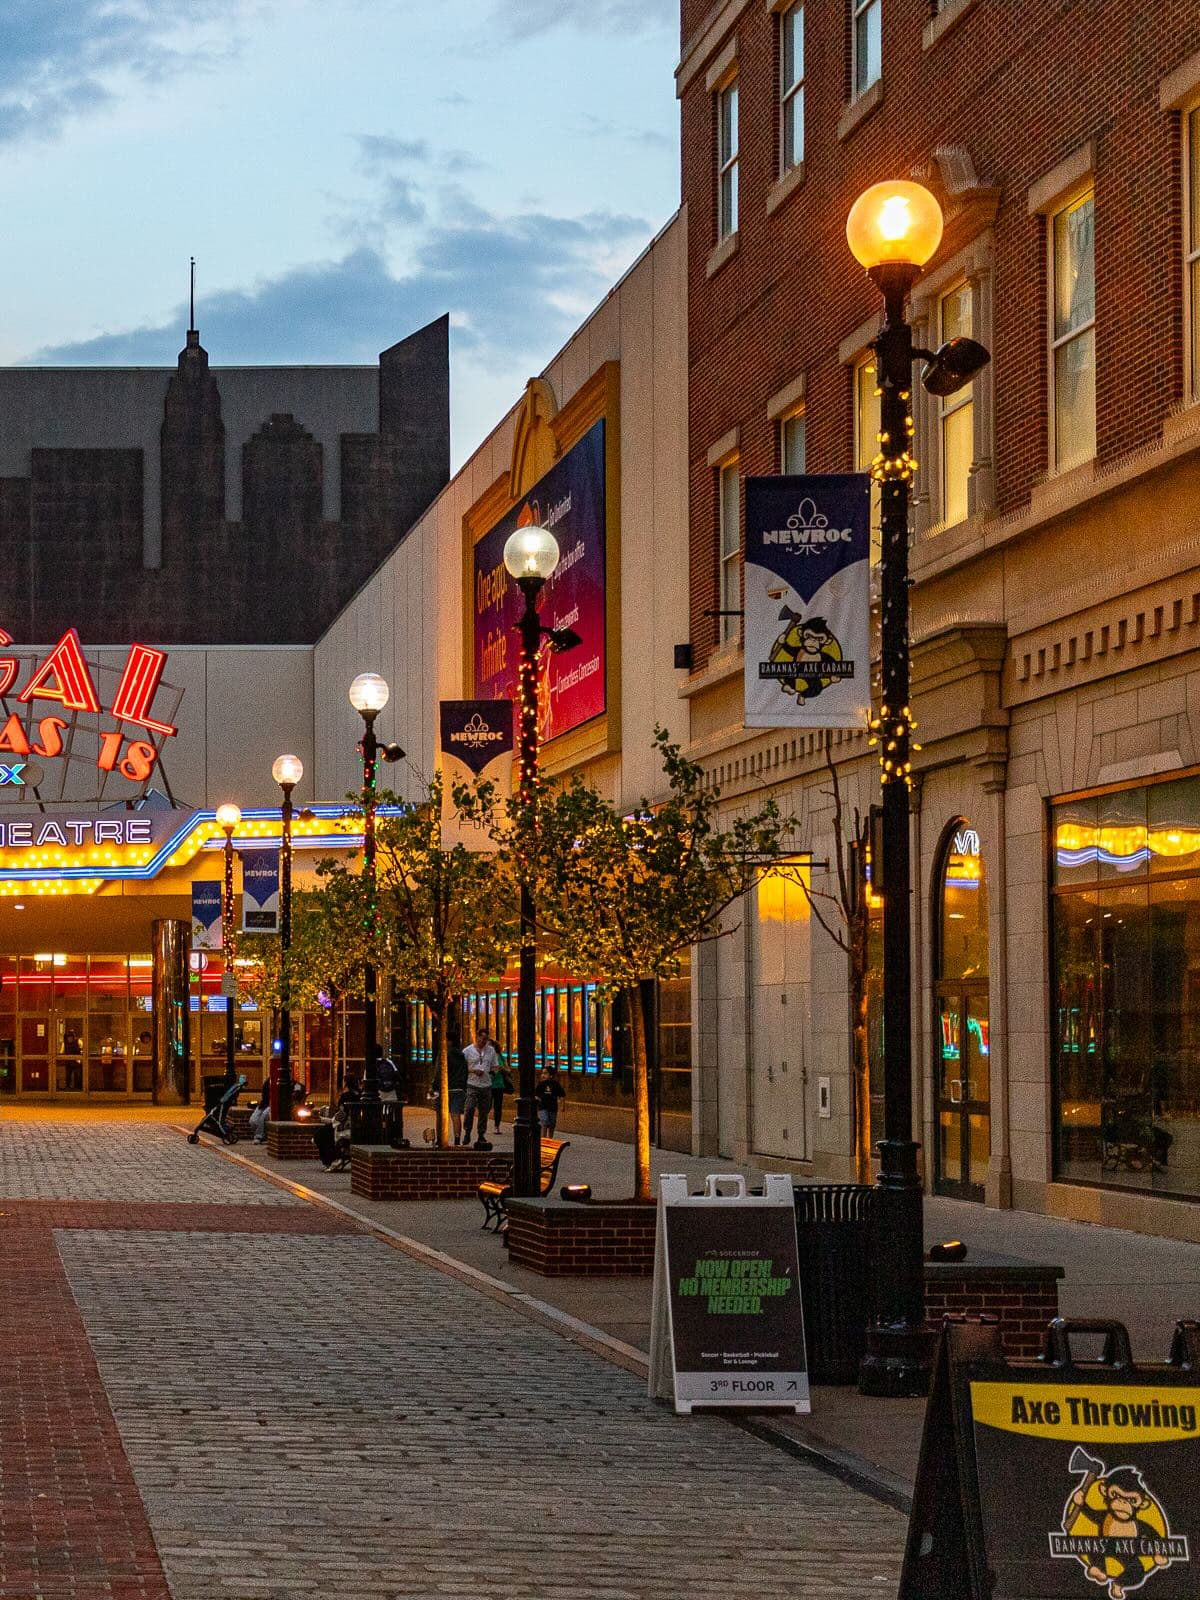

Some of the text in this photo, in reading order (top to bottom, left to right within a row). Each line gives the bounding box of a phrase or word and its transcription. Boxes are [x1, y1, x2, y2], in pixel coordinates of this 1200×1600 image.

[762, 528, 853, 545] NEWROC
[478, 569, 491, 614] One
[481, 626, 506, 682] Infinite
[804, 663, 818, 673] AXE
[821, 663, 852, 673] CABANA
[450, 732, 504, 742] NEWROC
[97, 731, 158, 782] 18
[695, 1260, 772, 1278] NOW OPEN!
[678, 1278, 791, 1296] NO MEMBERSHIP
[708, 1296, 764, 1314] NEEDED.
[732, 1381, 774, 1392] FLOOR
[1010, 1396, 1197, 1432] Axe Throwing
[1115, 1540, 1135, 1554] AXE
[1140, 1540, 1182, 1555] CABANA
